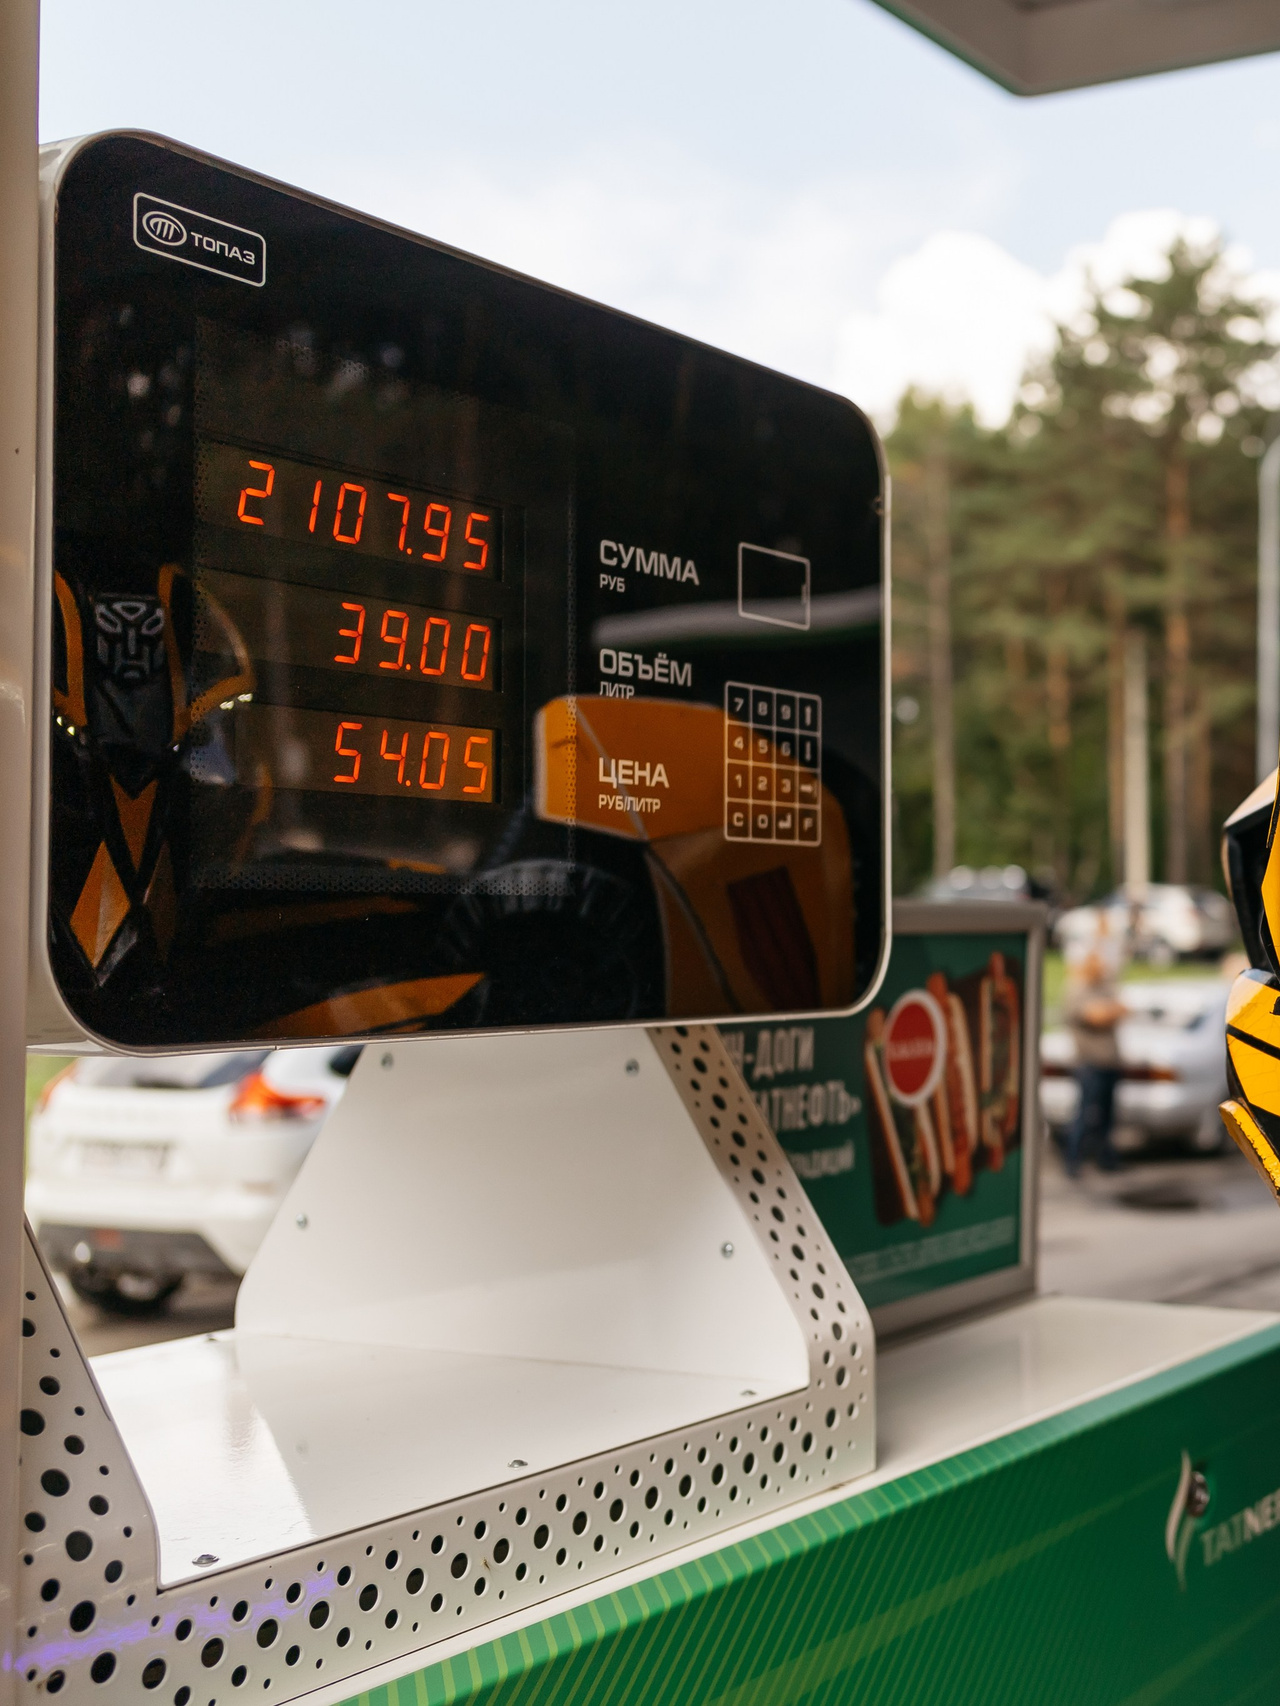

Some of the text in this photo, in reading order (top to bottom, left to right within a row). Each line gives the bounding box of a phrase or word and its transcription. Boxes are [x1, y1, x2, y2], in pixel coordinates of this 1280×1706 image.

[191, 231, 255, 265] ТОПАЗ
[237, 460, 490, 570] 2107.95
[600, 539, 700, 586] СУММА
[600, 573, 626, 593] РУБ
[334, 602, 491, 681] 39.00
[600, 648, 692, 687] ОБЪЁМ
[600, 681, 635, 699] ЛИТР
[734, 698, 791, 720] 7 8 9
[333, 721, 489, 793] 54.05
[733, 736, 791, 756] 4 5 6
[599, 757, 670, 789] ЦЕНА
[735, 774, 791, 794] 1 2 3
[599, 794, 661, 813] РУБ/ЛИТР
